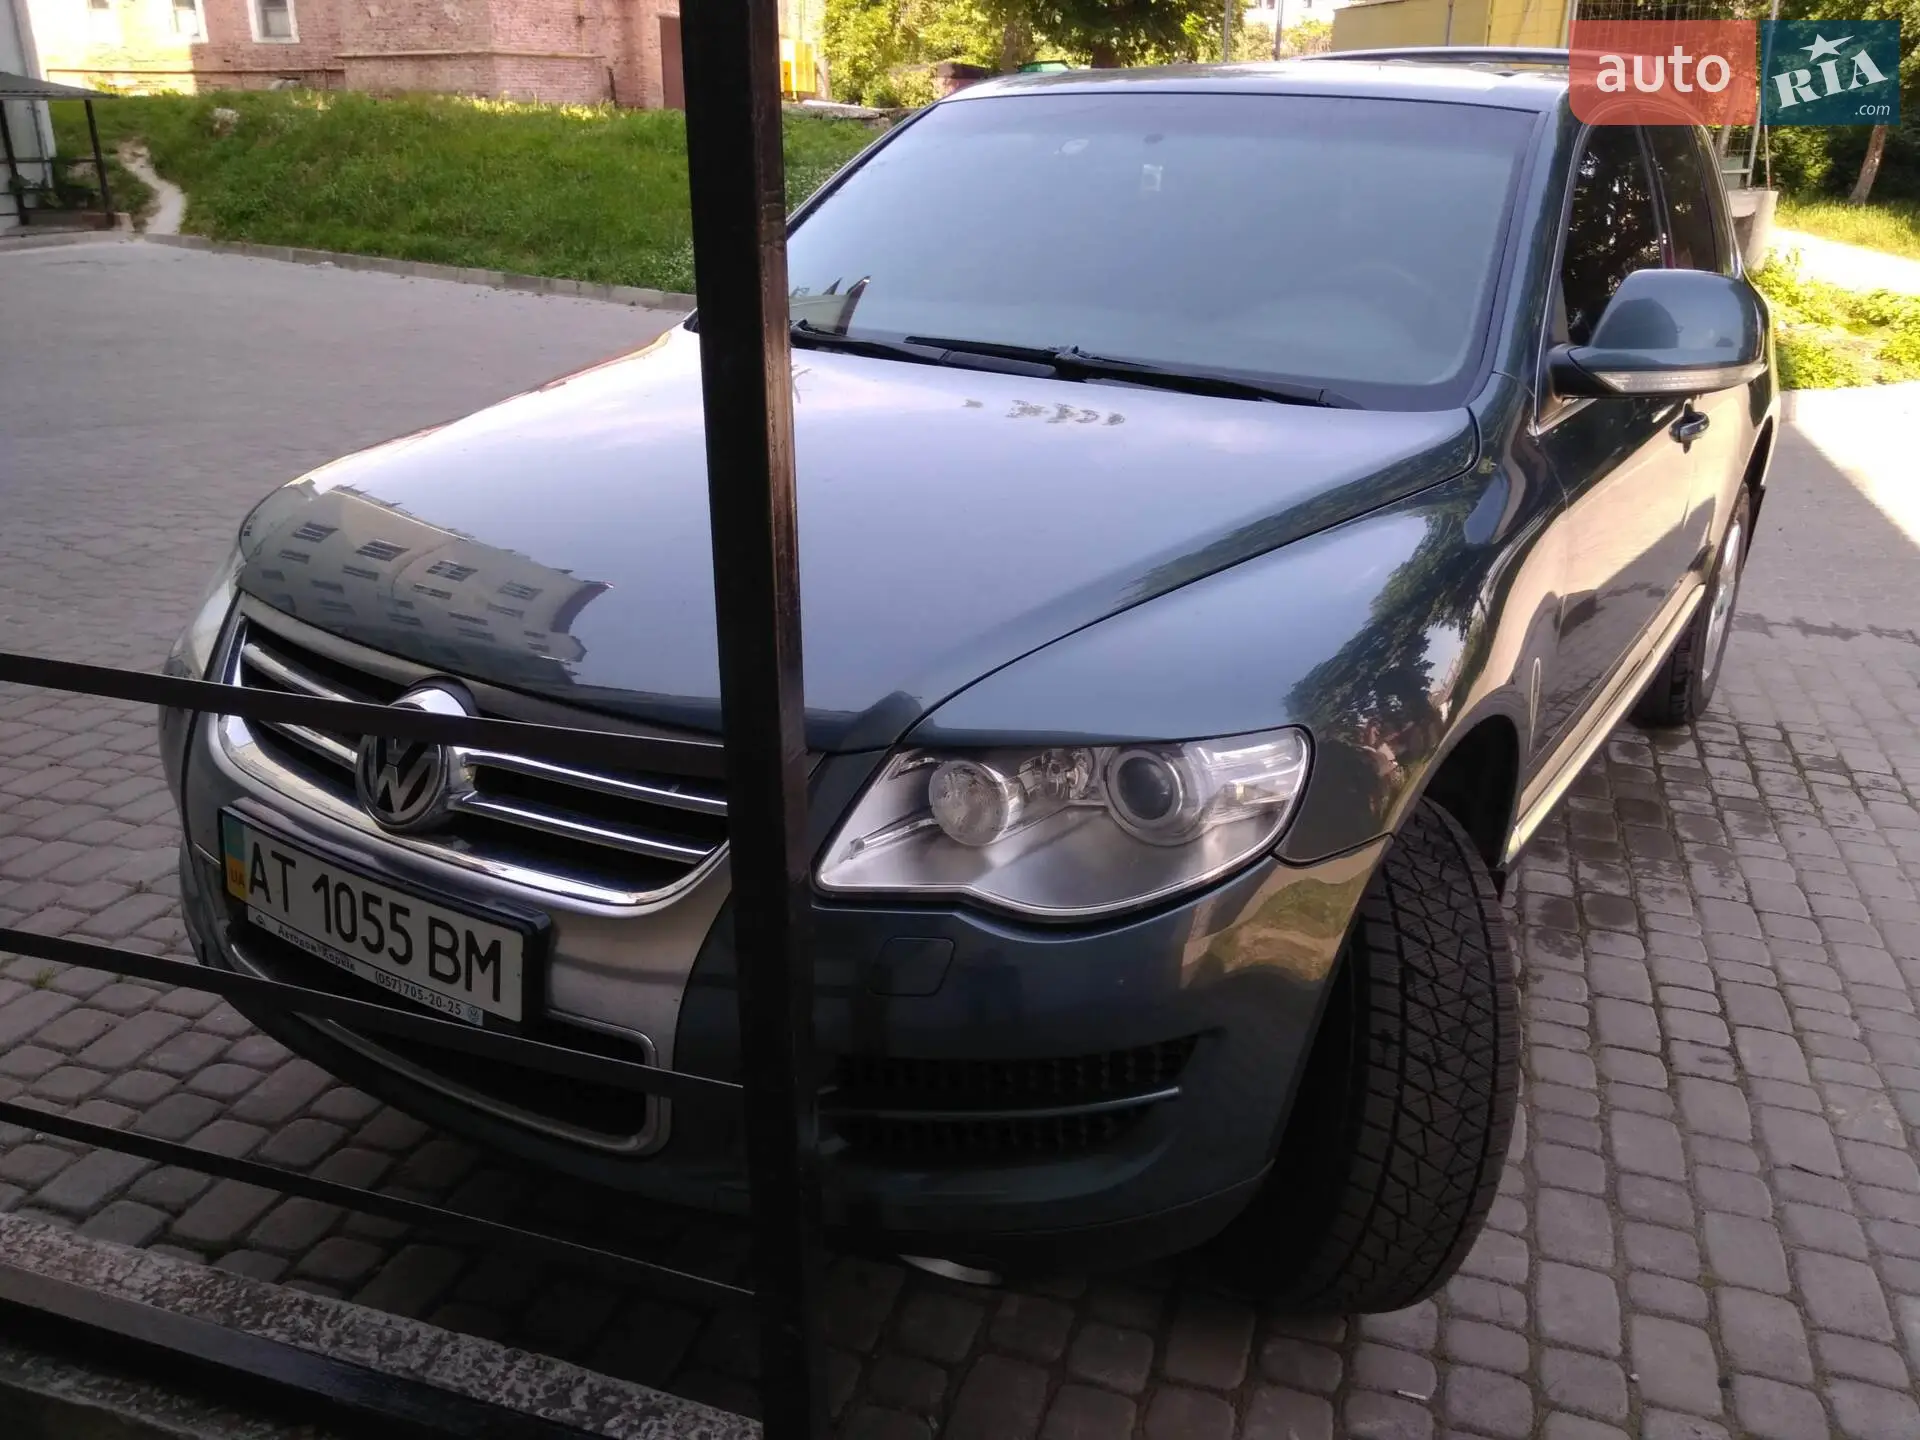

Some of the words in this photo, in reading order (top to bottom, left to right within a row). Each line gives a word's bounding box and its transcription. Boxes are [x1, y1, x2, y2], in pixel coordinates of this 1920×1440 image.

[230, 867, 246, 889] UA
[249, 841, 297, 914] AT
[312, 873, 414, 966] 1055
[428, 915, 502, 1003] BM
